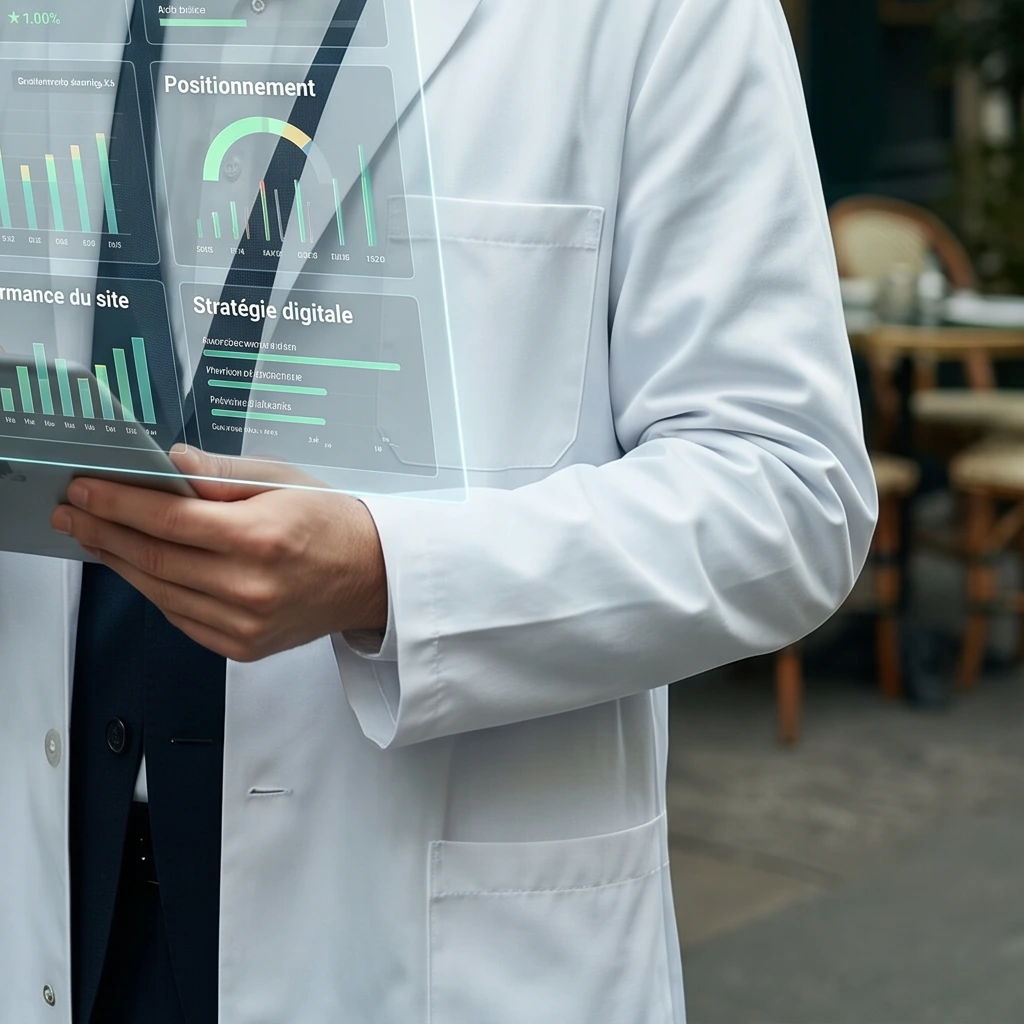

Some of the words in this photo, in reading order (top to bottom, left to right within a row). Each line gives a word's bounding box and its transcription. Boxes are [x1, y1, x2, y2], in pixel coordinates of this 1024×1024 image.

[164, 75, 316, 97] Positionnement
[69, 288, 91, 306] du
[96, 290, 130, 308] site
[193, 296, 277, 322] Stratégie
[282, 301, 354, 326] digitale
